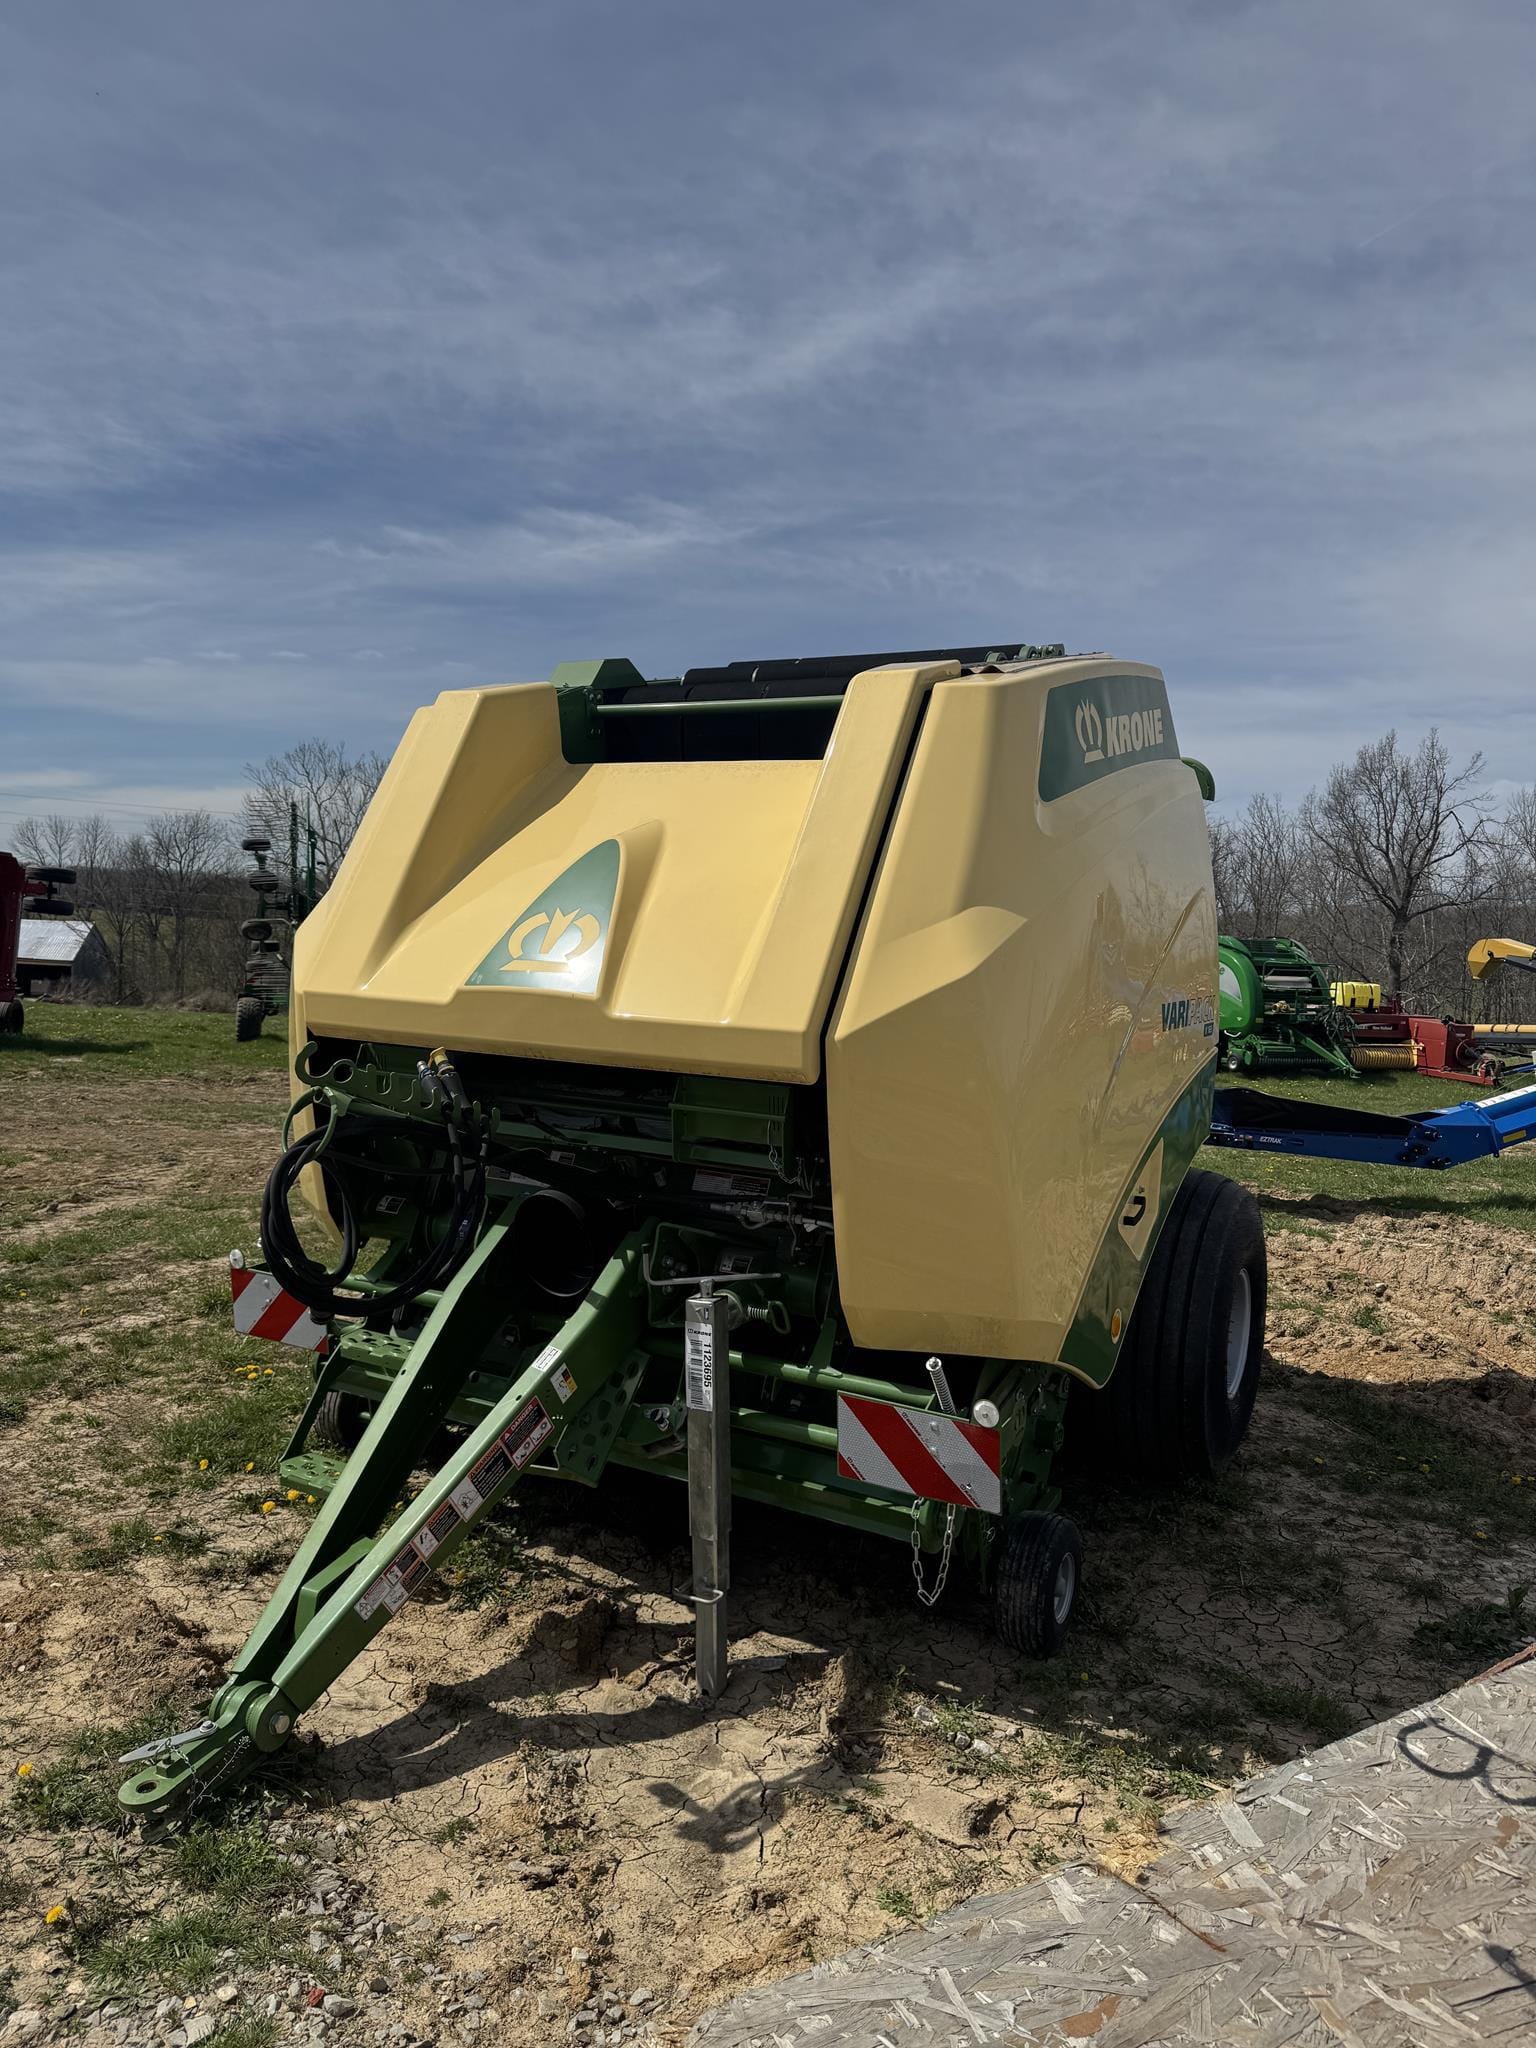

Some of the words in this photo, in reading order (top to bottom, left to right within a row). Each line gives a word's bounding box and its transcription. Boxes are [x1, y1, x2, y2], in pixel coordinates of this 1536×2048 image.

[1106, 709, 1164, 757] KRONE
[1260, 1136, 1282, 1144] EZTRAK
[703, 1342, 712, 1388] 1123695
[510, 1404, 533, 1431] DANGER
